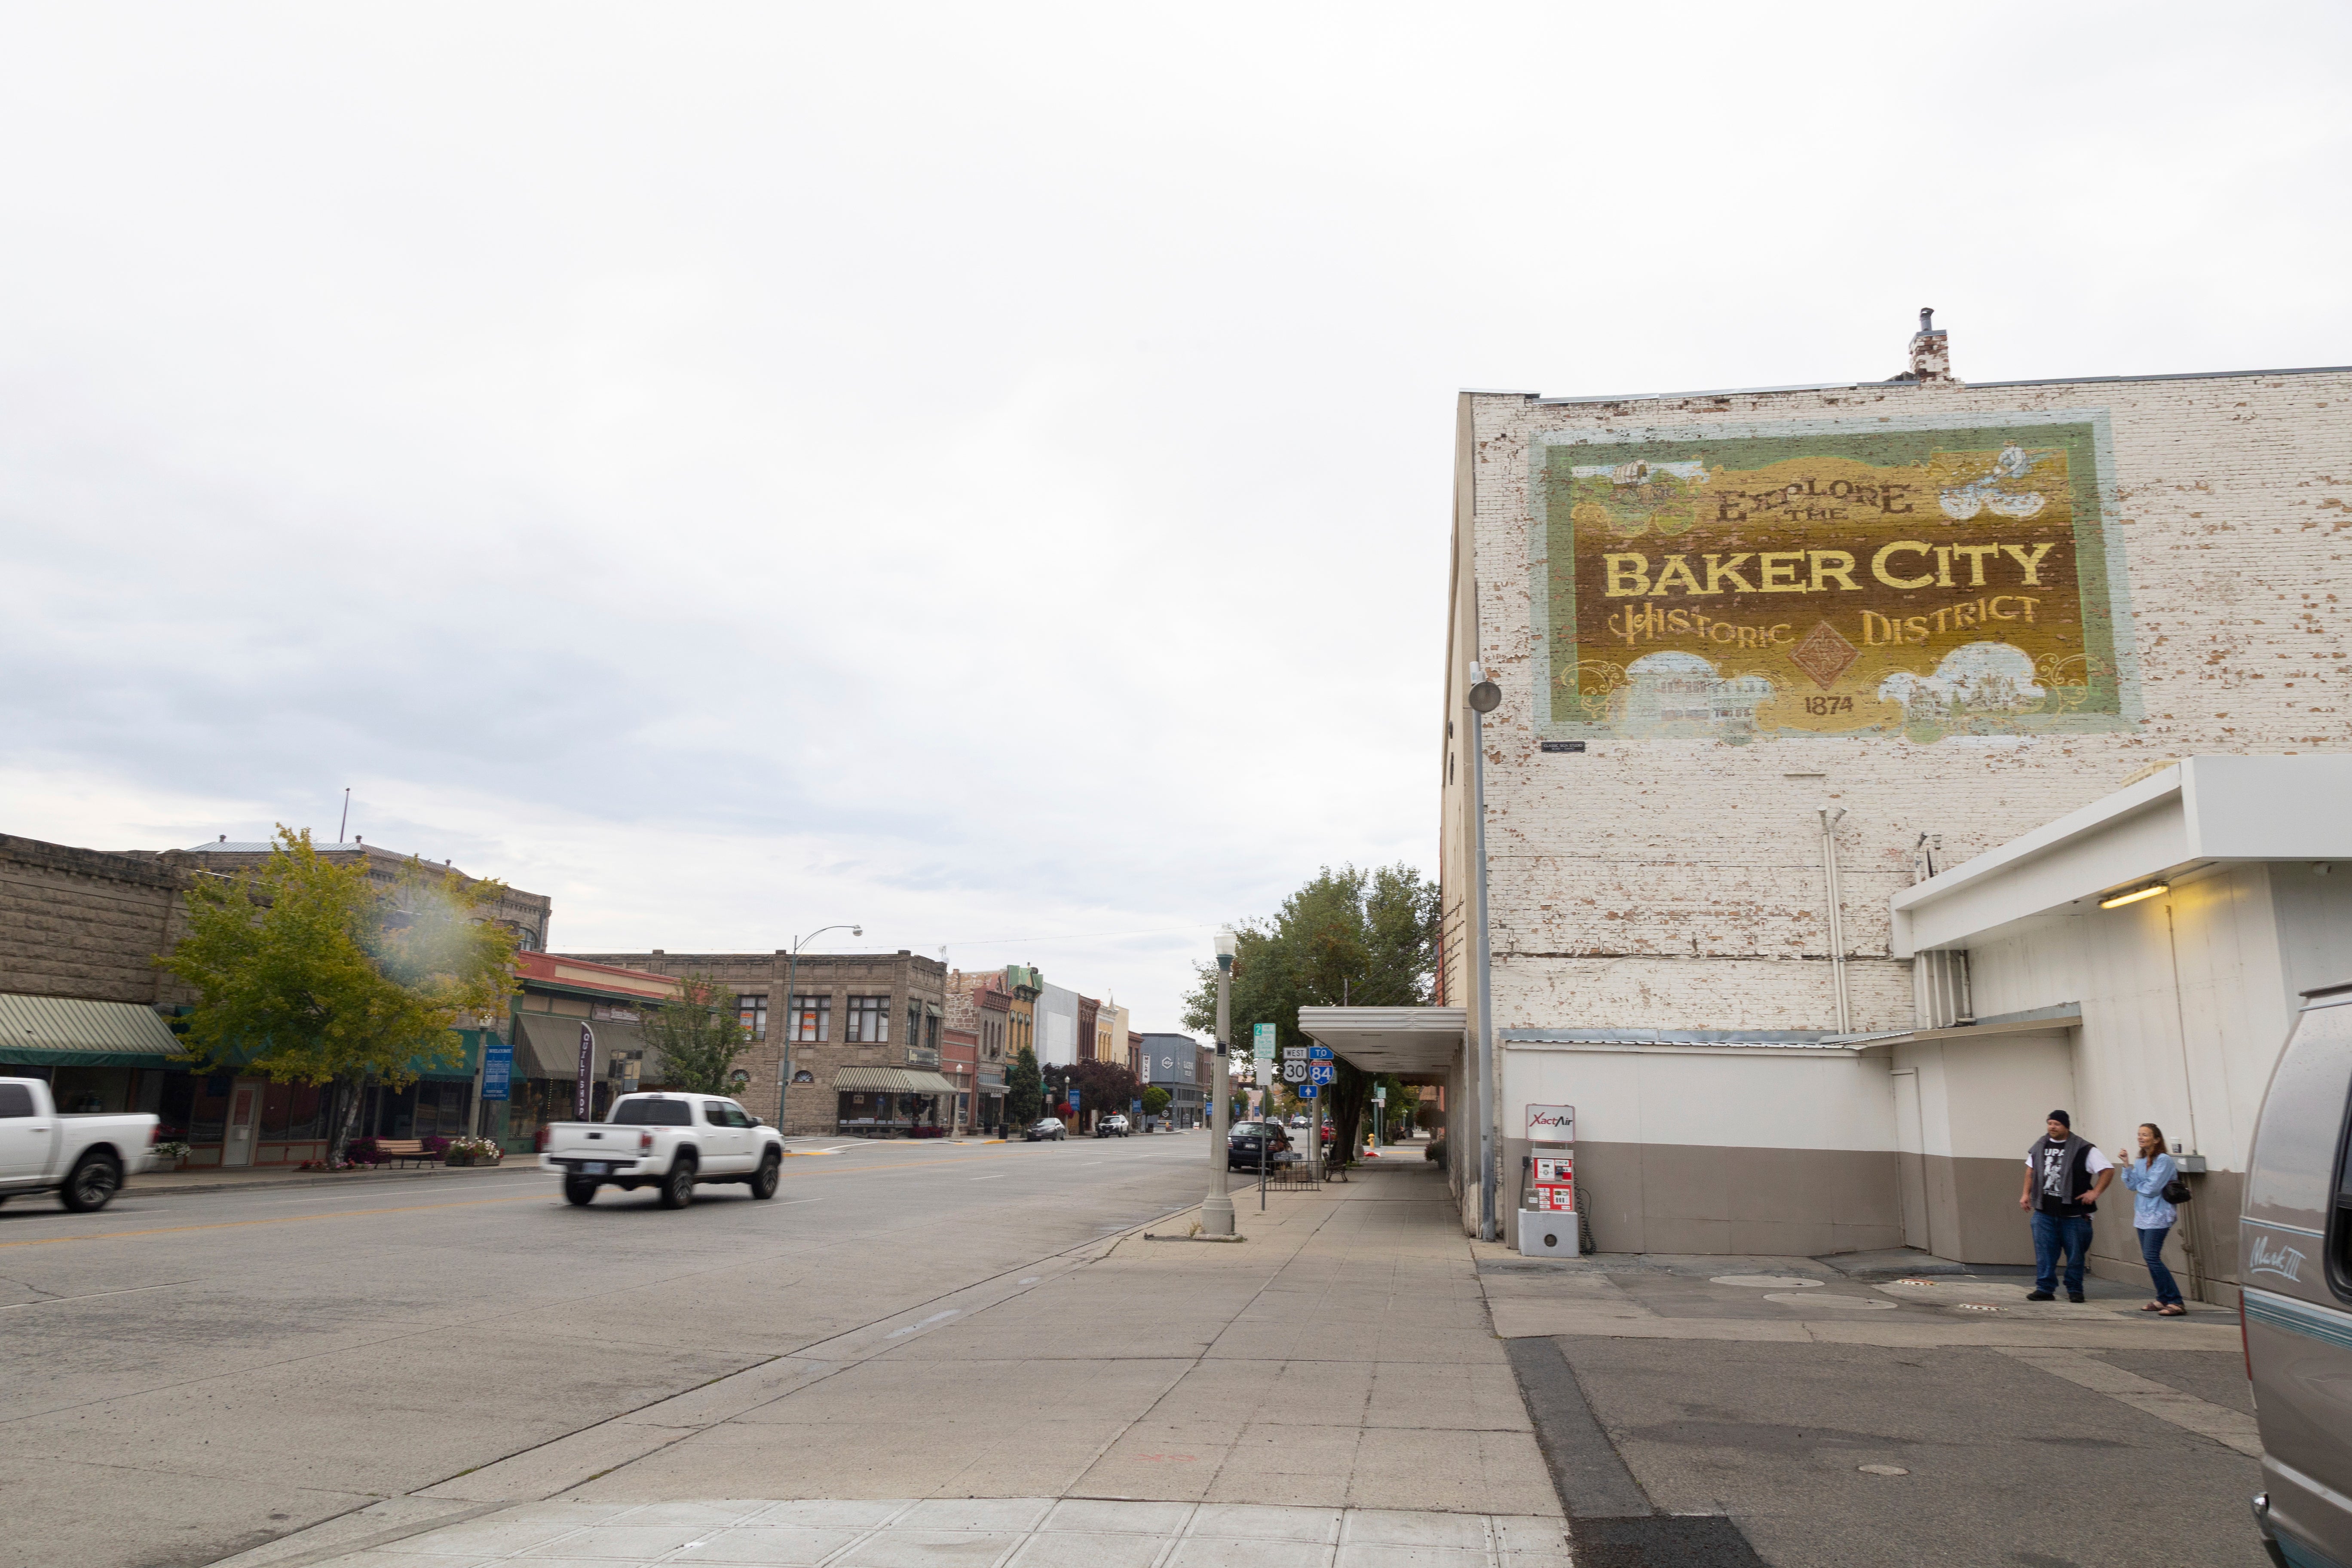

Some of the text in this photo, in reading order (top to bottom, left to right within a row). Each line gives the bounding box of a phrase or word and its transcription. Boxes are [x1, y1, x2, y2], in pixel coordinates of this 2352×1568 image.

[1715, 477, 1914, 521] EXPLORE
[1783, 505, 1848, 521] THE
[1602, 540, 2056, 597] BAKER CITY
[1608, 595, 2040, 648] HISTORIC DISTRICT
[1805, 695, 1853, 716] 1874
[1256, 1025, 1261, 1035] 2
[580, 1033, 590, 1077] QUILT
[1286, 1064, 1305, 1078] 30
[1312, 1067, 1331, 1080] 84
[1528, 1112, 1573, 1127] XactAir
[2250, 1235, 2289, 1269] Mark
